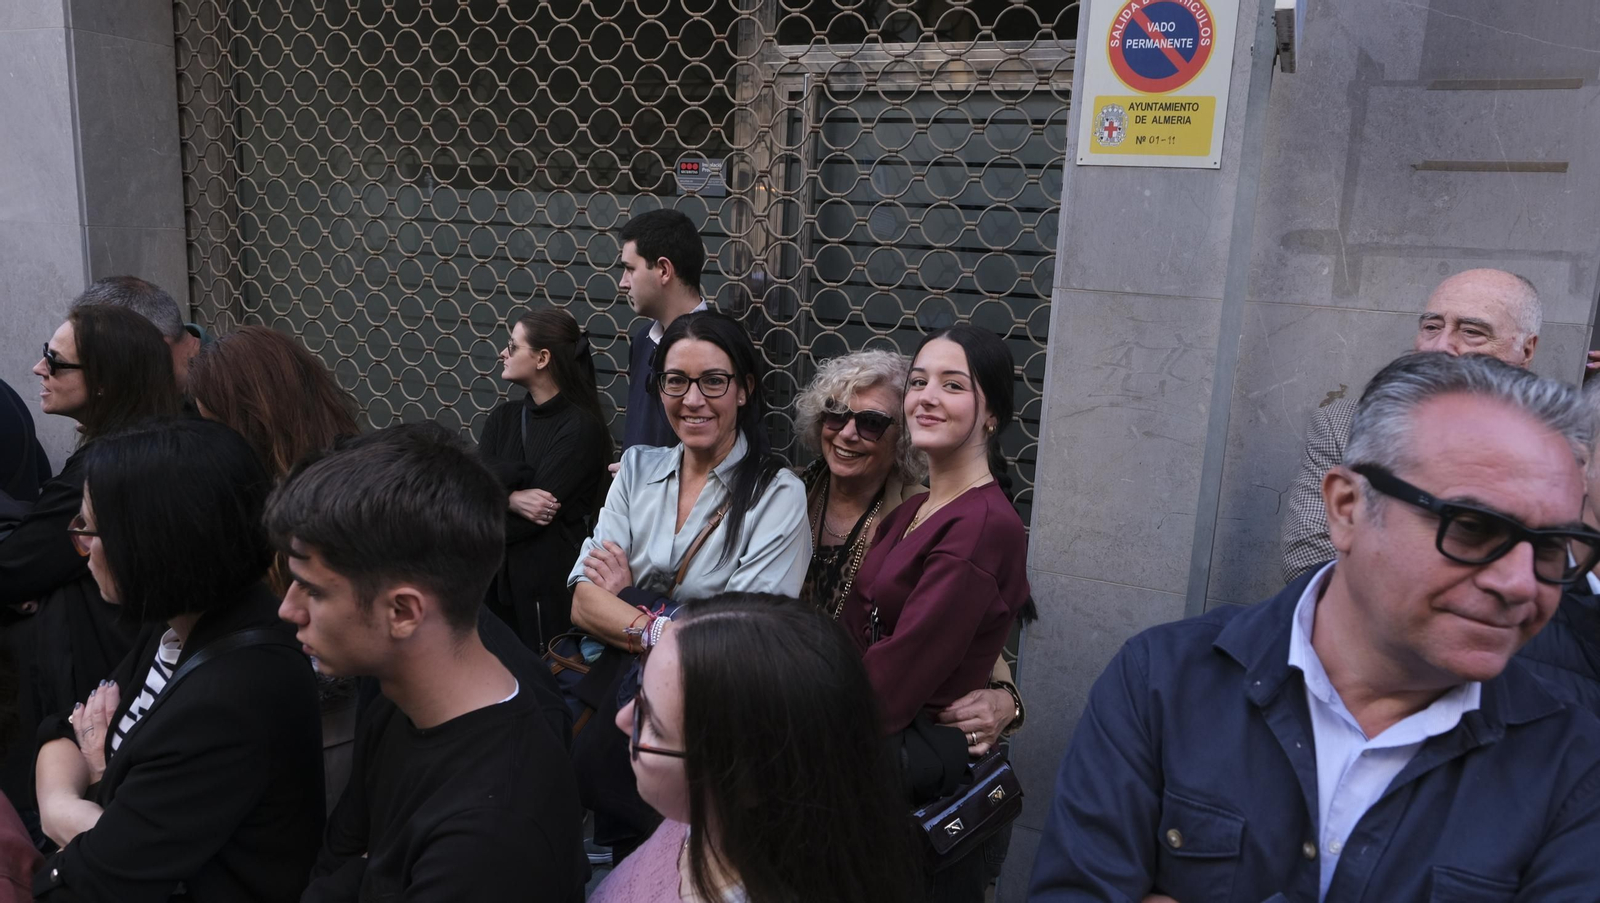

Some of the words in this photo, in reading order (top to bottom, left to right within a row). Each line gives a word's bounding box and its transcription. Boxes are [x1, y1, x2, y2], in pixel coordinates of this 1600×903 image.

[1110, 3, 1140, 47] SALIDA
[1147, 22, 1176, 32] VADO
[1126, 38, 1194, 49] PERMANENTE
[1128, 102, 1199, 112] AYUNTAMIENTO
[1134, 115, 1147, 124] DE
[1151, 115, 1192, 125] ALMERIA
